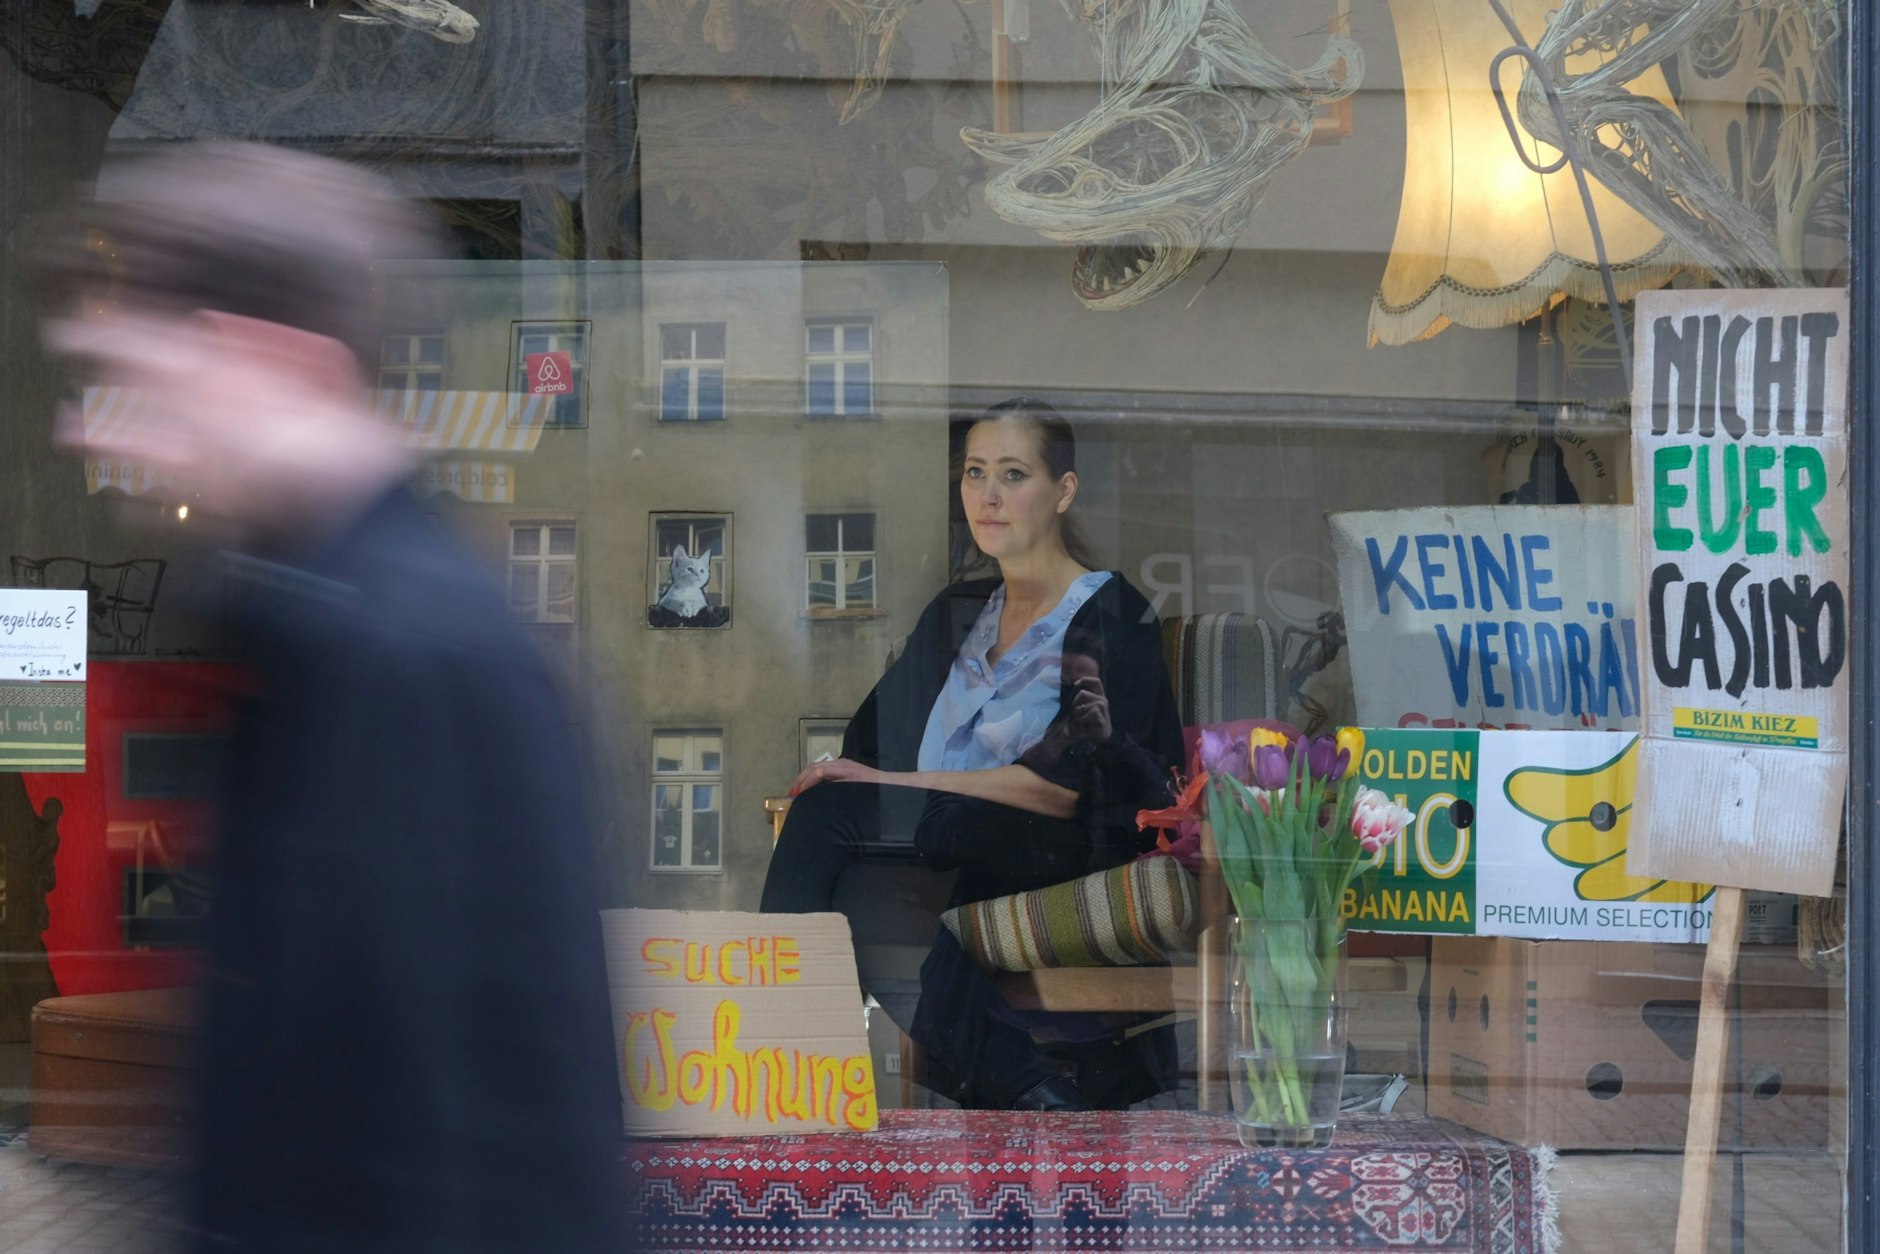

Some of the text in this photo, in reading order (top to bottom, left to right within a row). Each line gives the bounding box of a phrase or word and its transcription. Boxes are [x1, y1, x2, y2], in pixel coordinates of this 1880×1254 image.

[535, 382, 566, 393] airbnb
[1651, 312, 1839, 439] NICHT
[1653, 444, 1832, 557] EUER
[1365, 533, 1562, 615] KEINE
[1649, 562, 1846, 699] CASINO
[1363, 749, 1471, 781] OLDEN
[1340, 888, 1471, 923] BANANA
[1484, 904, 1588, 926] PREMIUM
[641, 936, 800, 985] SUCHE
[622, 1000, 877, 1130] Wohnung
